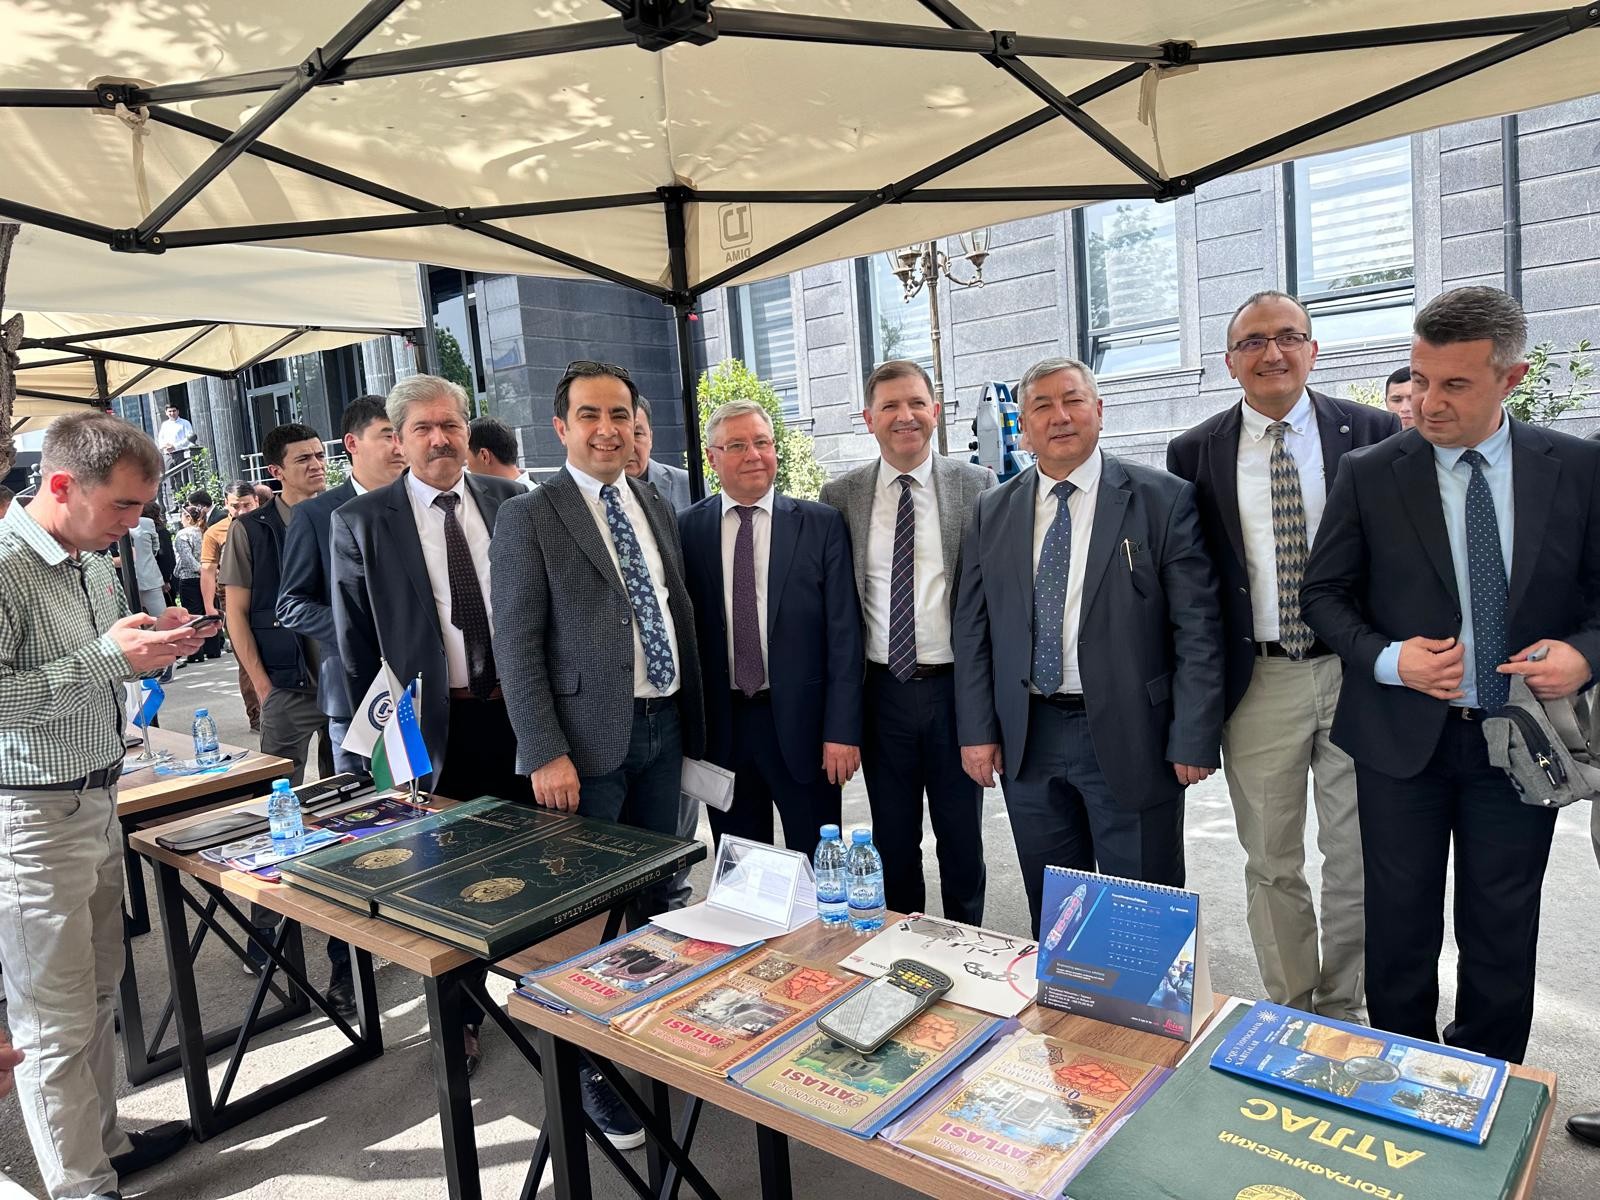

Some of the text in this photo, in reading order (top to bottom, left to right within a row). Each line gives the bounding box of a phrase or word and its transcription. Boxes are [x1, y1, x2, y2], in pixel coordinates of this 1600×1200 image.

[554, 907, 583, 924] ATLASI
[585, 892, 613, 911] MILLIY
[567, 972, 617, 998] ATLASI
[662, 1017, 723, 1045] ATLASI
[781, 1068, 855, 1100] ATLASI
[939, 1123, 1030, 1160] ATLASI
[1240, 1098, 1426, 1169] АТЛАС
[1218, 1130, 1404, 1200] ГЕОГРАФИЧЕСКИЙ
